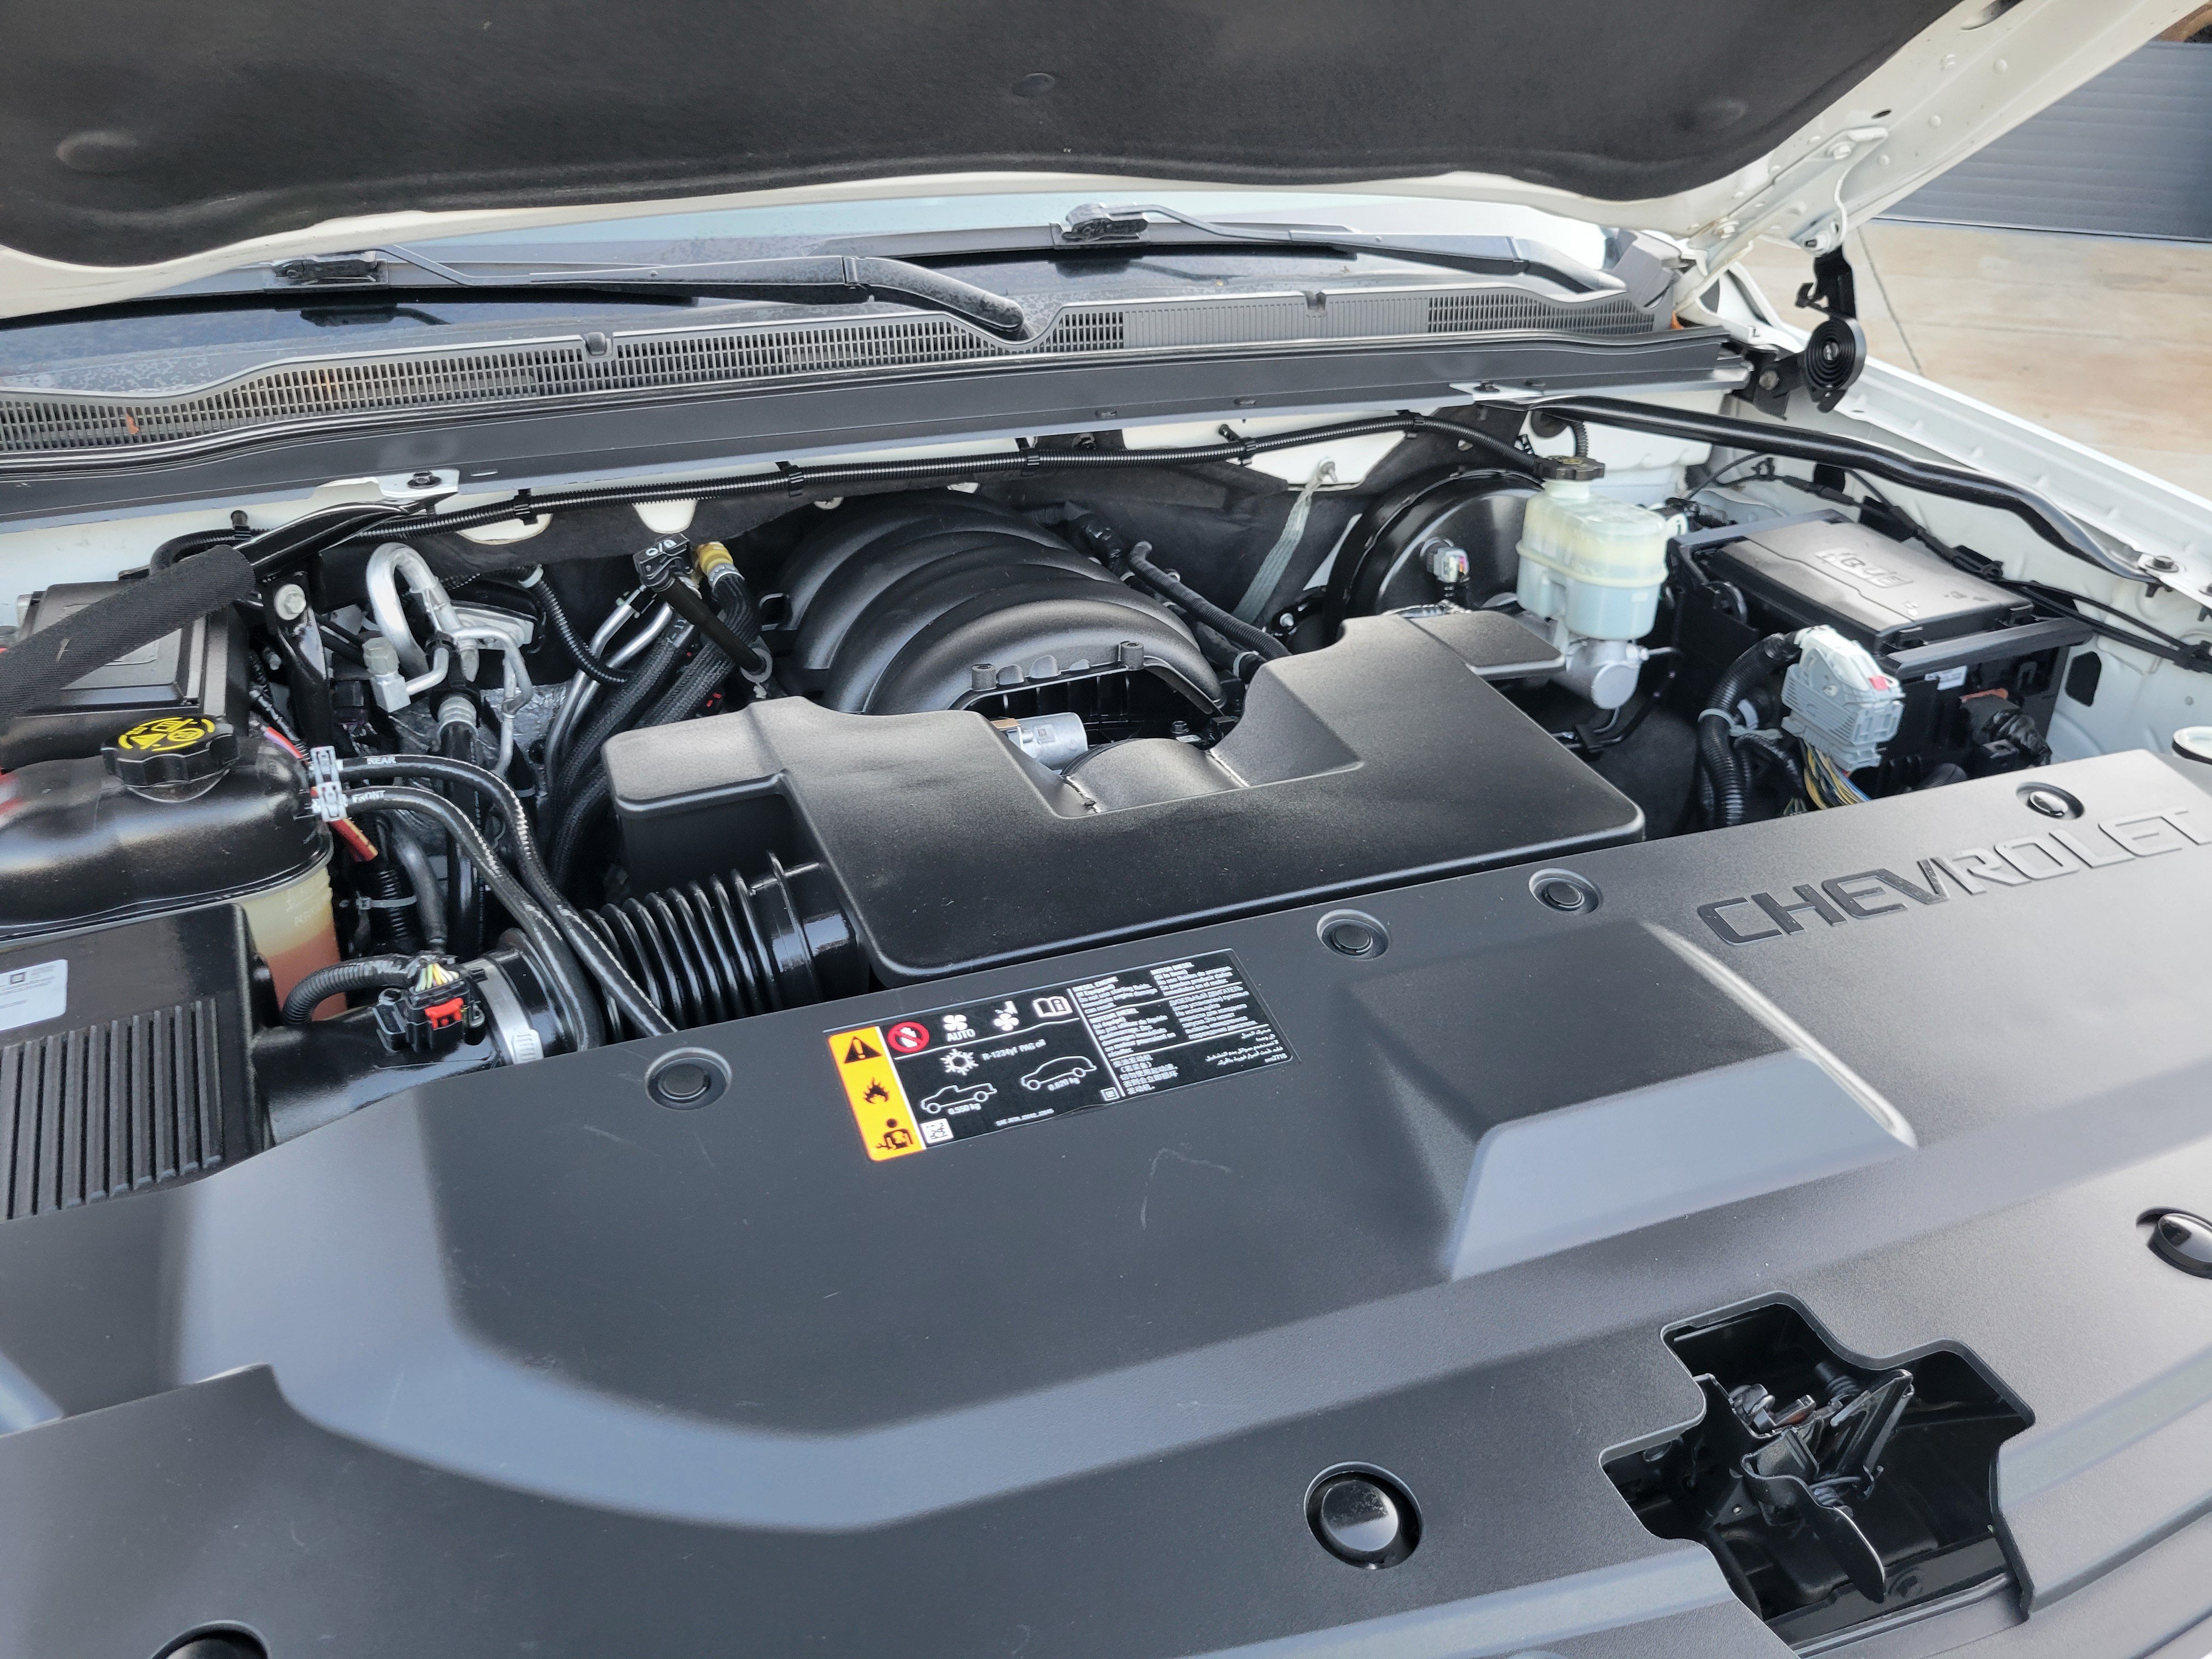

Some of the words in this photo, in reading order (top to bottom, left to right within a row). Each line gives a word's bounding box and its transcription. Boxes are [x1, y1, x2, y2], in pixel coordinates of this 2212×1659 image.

[366, 757, 397, 765] REAR
[351, 790, 386, 803] FRONT
[1697, 806, 2212, 946] CHEVROLET
[946, 1029, 975, 1042] AUTO
[981, 1047, 1018, 1061] R-1234yf
[1018, 1042, 1035, 1053] PAG
[1035, 1039, 1046, 1048] oil
[947, 1104, 970, 1115] 0.550
[970, 1103, 982, 1111] kg
